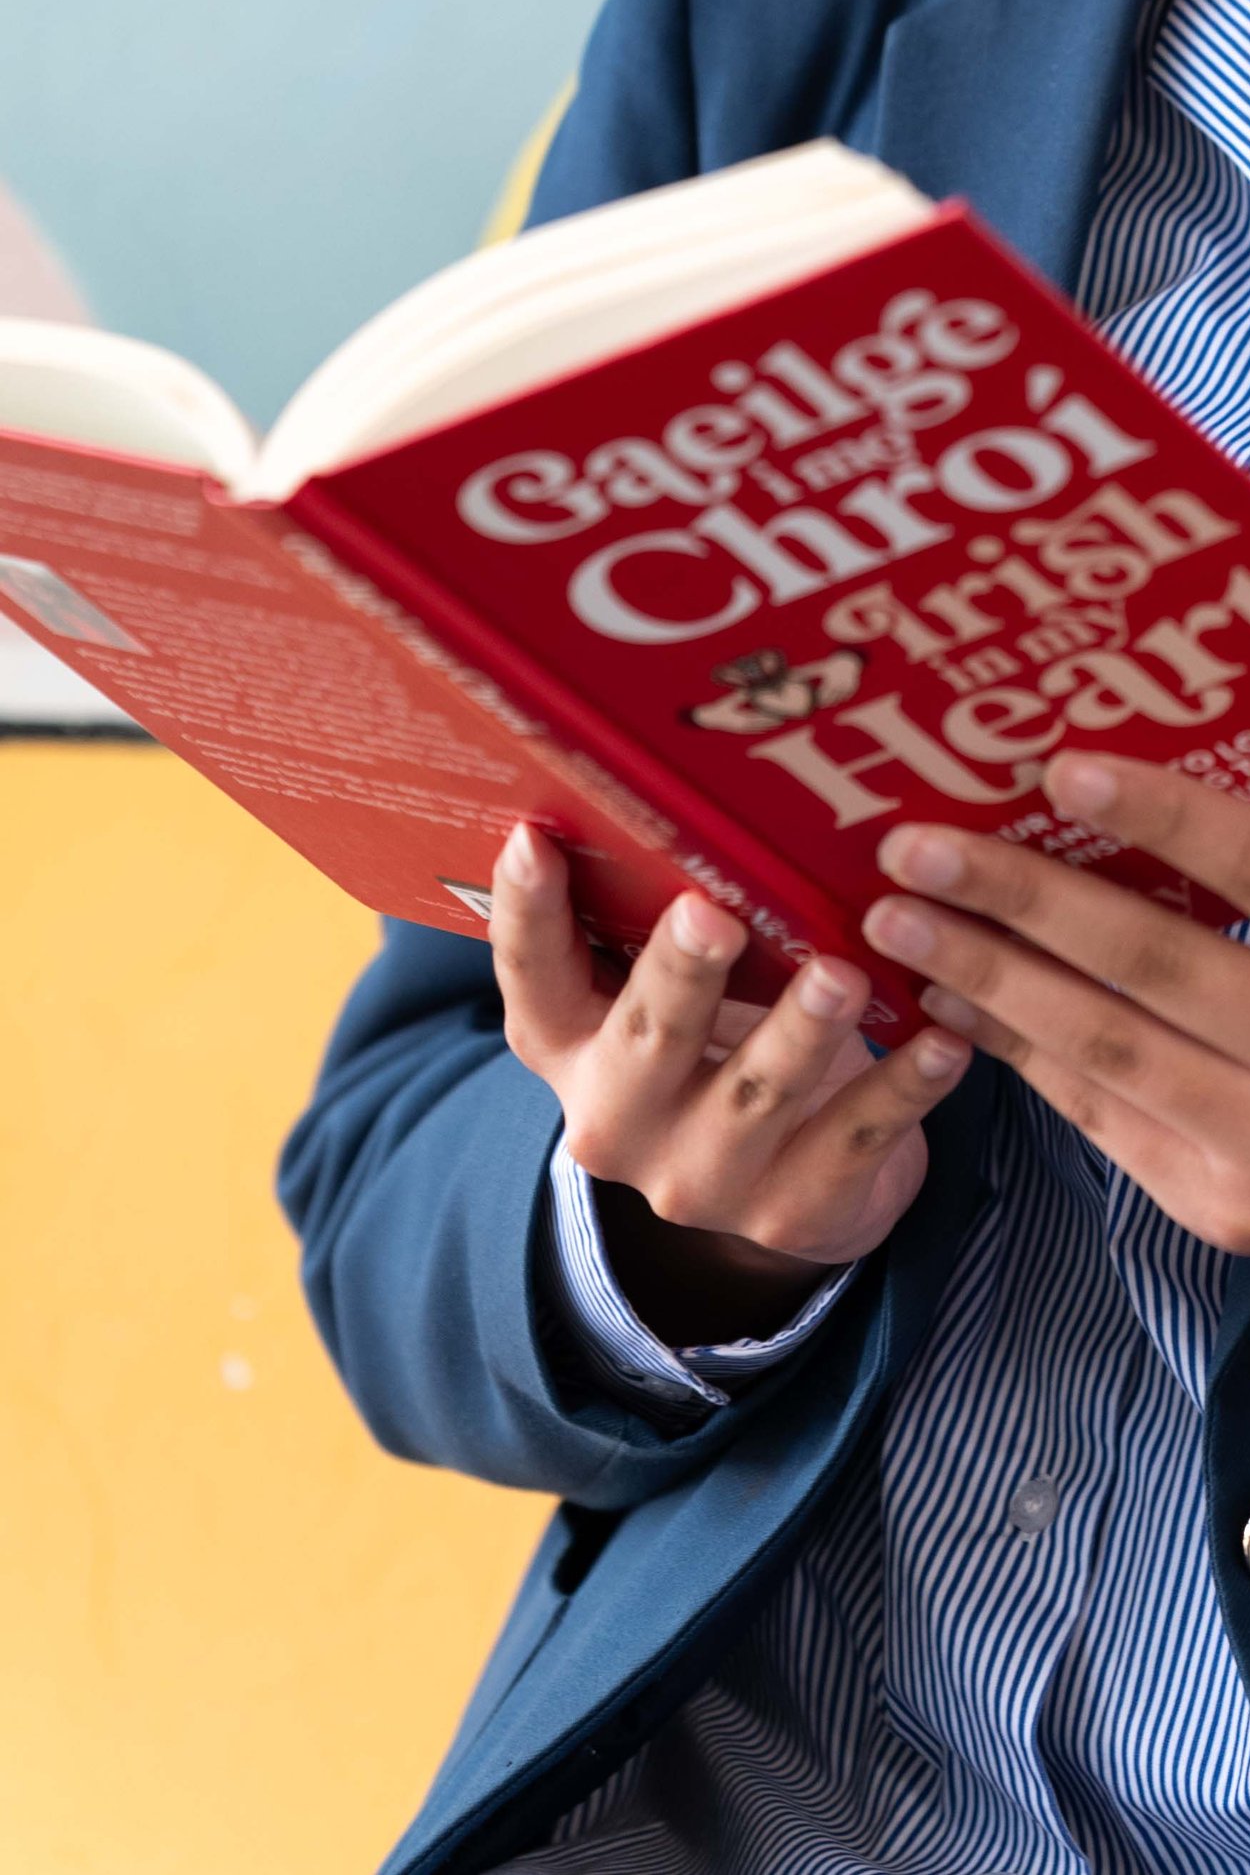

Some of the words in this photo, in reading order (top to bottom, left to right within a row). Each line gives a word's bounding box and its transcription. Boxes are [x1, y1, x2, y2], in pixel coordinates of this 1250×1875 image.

[456, 288, 1020, 545] Gaeilge
[567, 364, 1157, 645] Chroí
[822, 482, 1241, 664] Irish
[930, 646, 1023, 695] in
[1016, 599, 1131, 666] my
